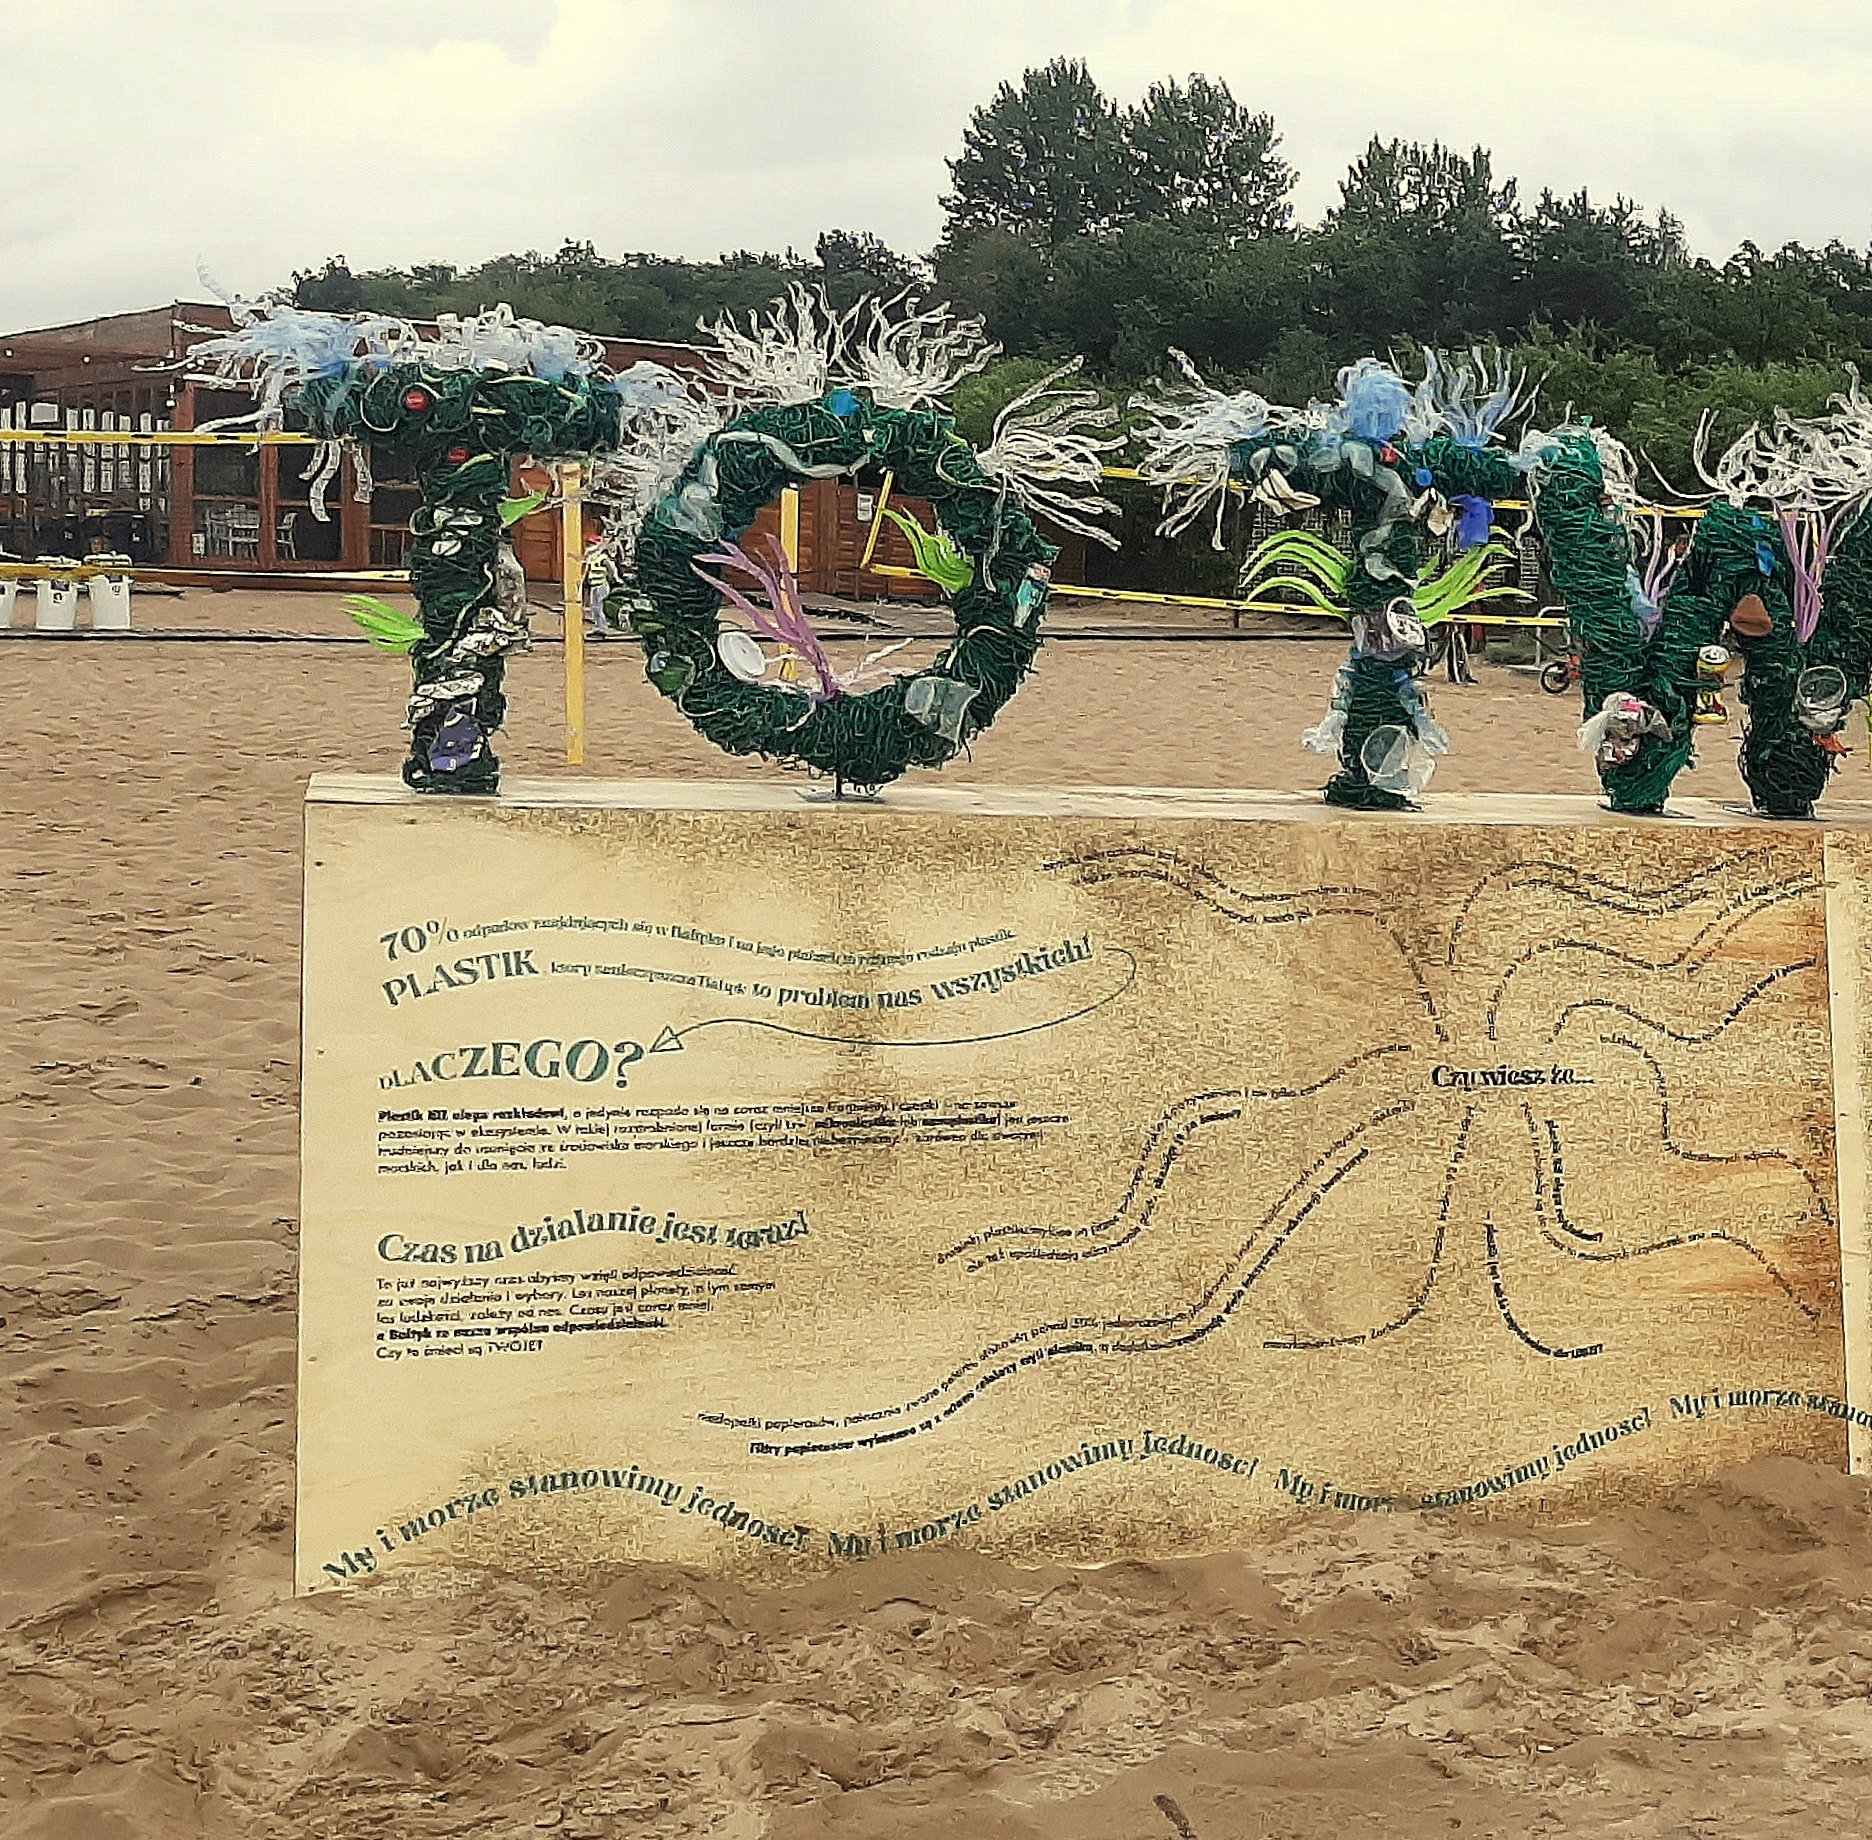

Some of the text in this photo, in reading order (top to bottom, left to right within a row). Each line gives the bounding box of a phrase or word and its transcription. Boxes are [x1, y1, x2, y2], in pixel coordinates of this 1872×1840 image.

[380, 916, 460, 961] 70%
[381, 948, 540, 1007] PLASTIK
[778, 986, 871, 1010] problem
[877, 988, 923, 1010] nas
[929, 932, 1094, 995] wszystkich!
[1479, 1063, 1547, 1087] wiesz
[556, 1124, 572, 1136] W
[377, 1233, 458, 1264] Czas
[463, 1239, 505, 1265] na
[655, 1211, 719, 1246] jest
[376, 1277, 393, 1290] To
[376, 1345, 403, 1361] Czy
[1668, 1392, 1708, 1420] My
[1712, 1387, 1722, 1410] i
[1727, 1388, 1802, 1409] morze
[894, 1504, 982, 1549] morze
[986, 1437, 1135, 1513] stanowimy
[323, 1544, 380, 1581] My
[376, 1528, 396, 1554] i
[399, 1485, 501, 1543] morze
[508, 1464, 684, 1507] stanowimy
